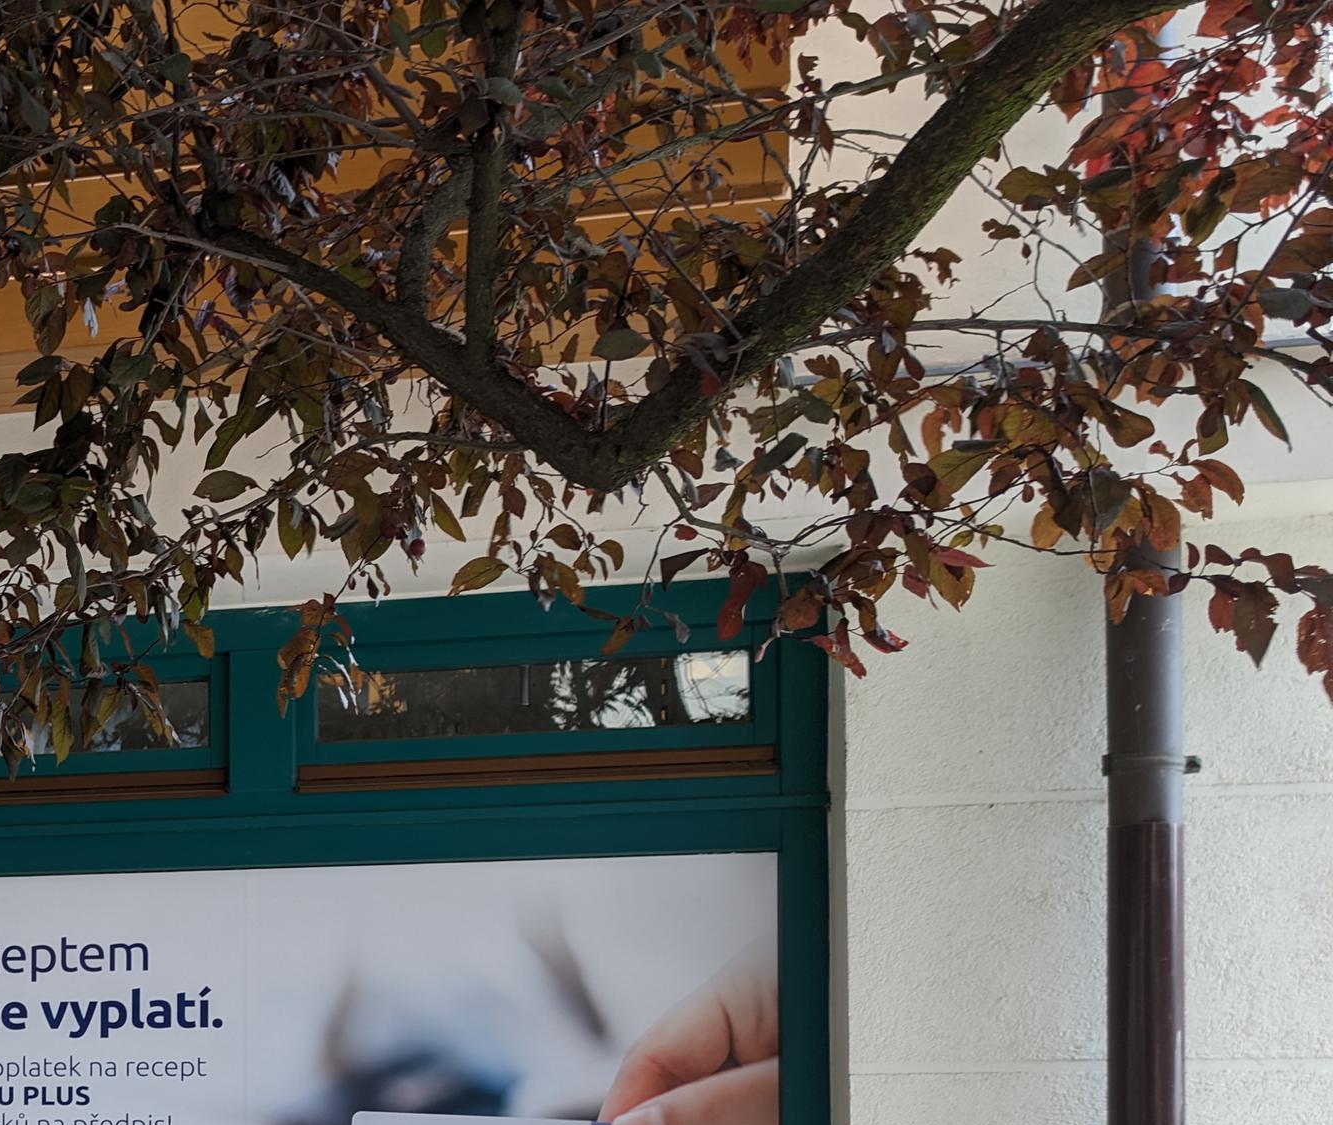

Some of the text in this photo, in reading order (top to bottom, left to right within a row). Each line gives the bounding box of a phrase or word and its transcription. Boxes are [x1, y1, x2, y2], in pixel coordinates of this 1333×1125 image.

[40, 986, 223, 1039] vyplatí.
[89, 1061, 117, 1078] na
[126, 1057, 207, 1081] recept
[23, 1086, 91, 1106] PLUS
